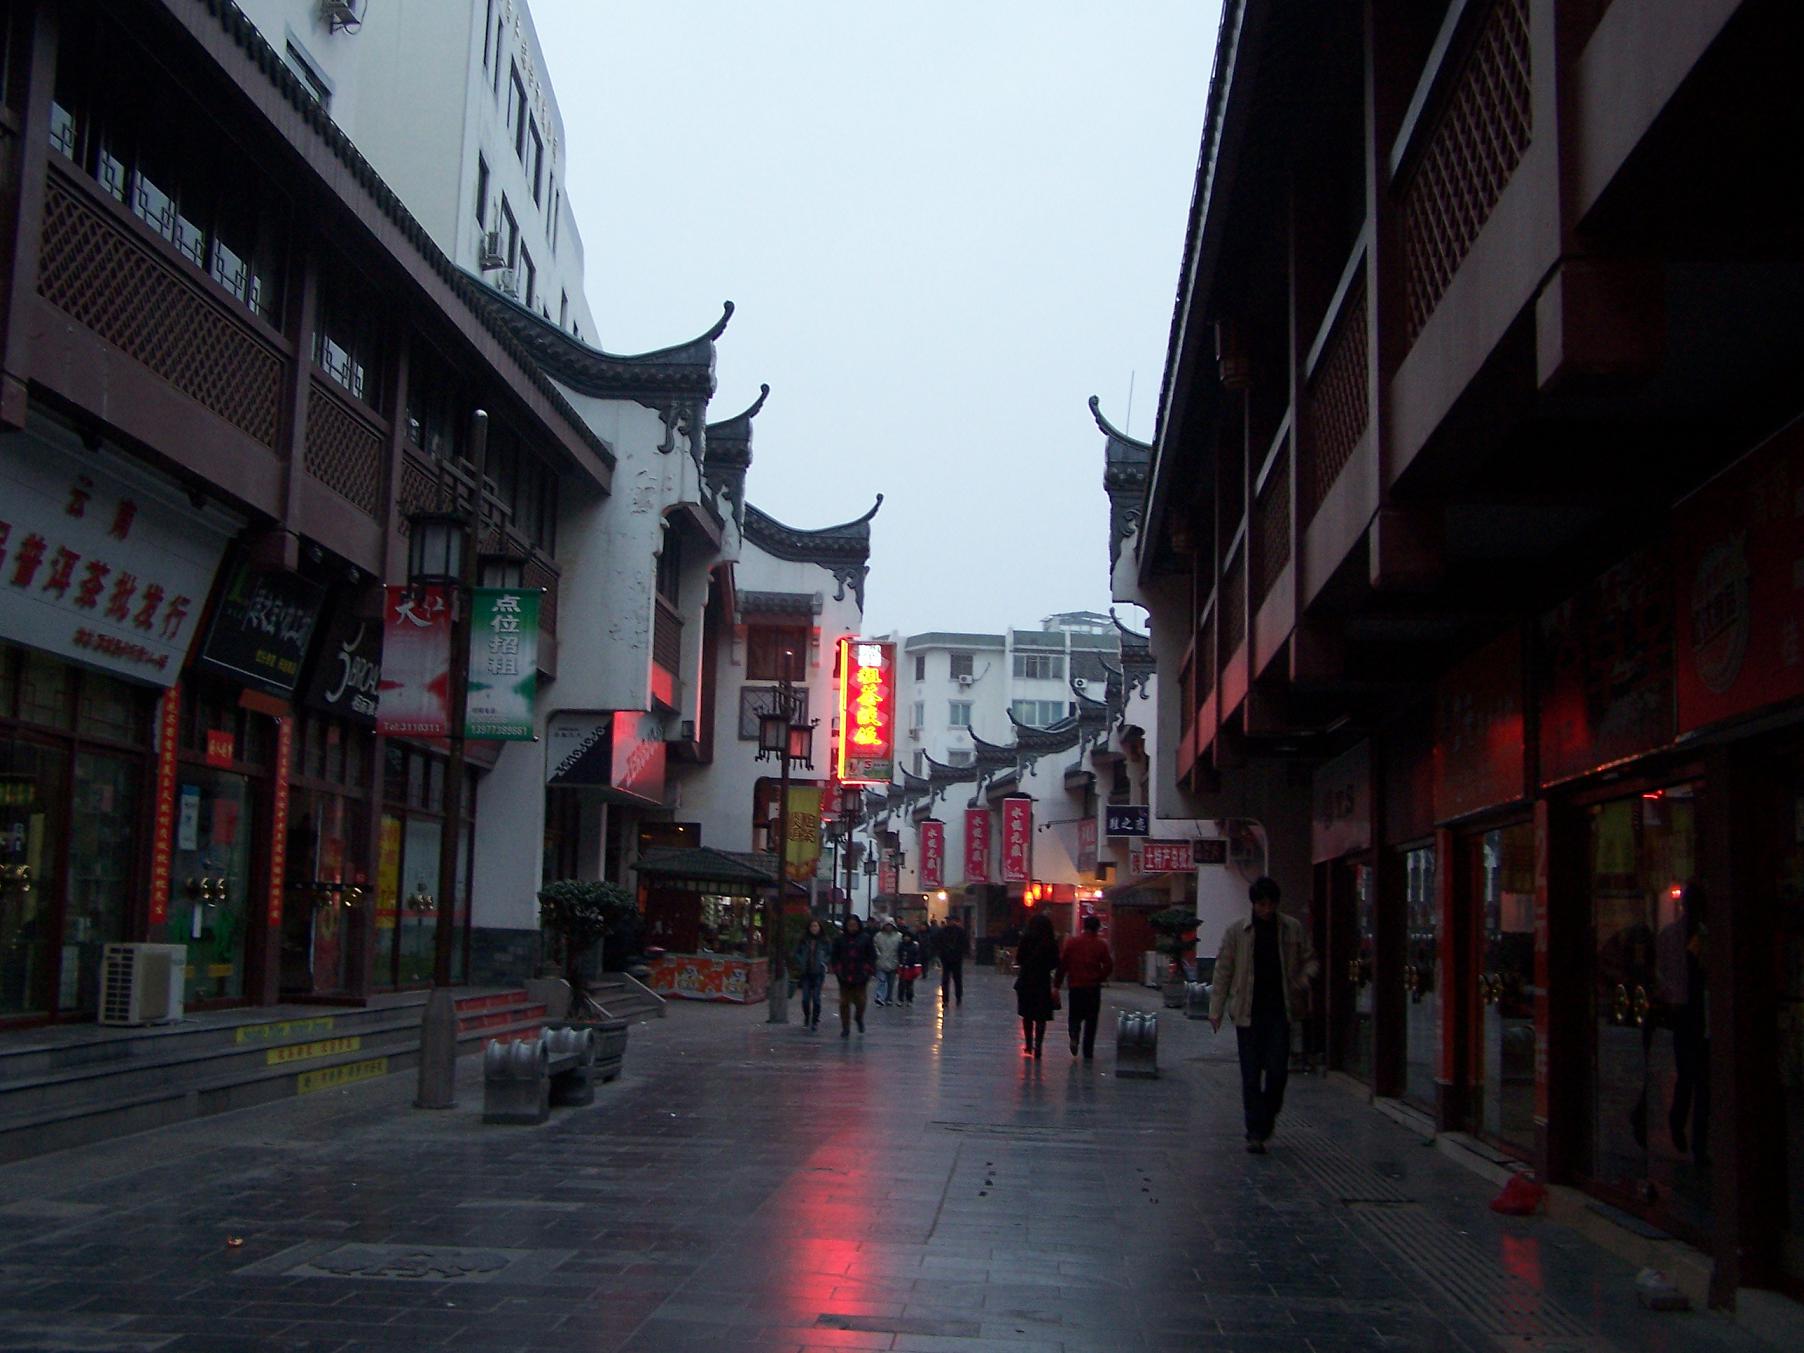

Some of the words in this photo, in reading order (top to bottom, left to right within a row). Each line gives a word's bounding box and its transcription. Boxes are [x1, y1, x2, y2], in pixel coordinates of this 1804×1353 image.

[65, 475, 138, 541] 云南
[488, 594, 522, 676] 点位招租
